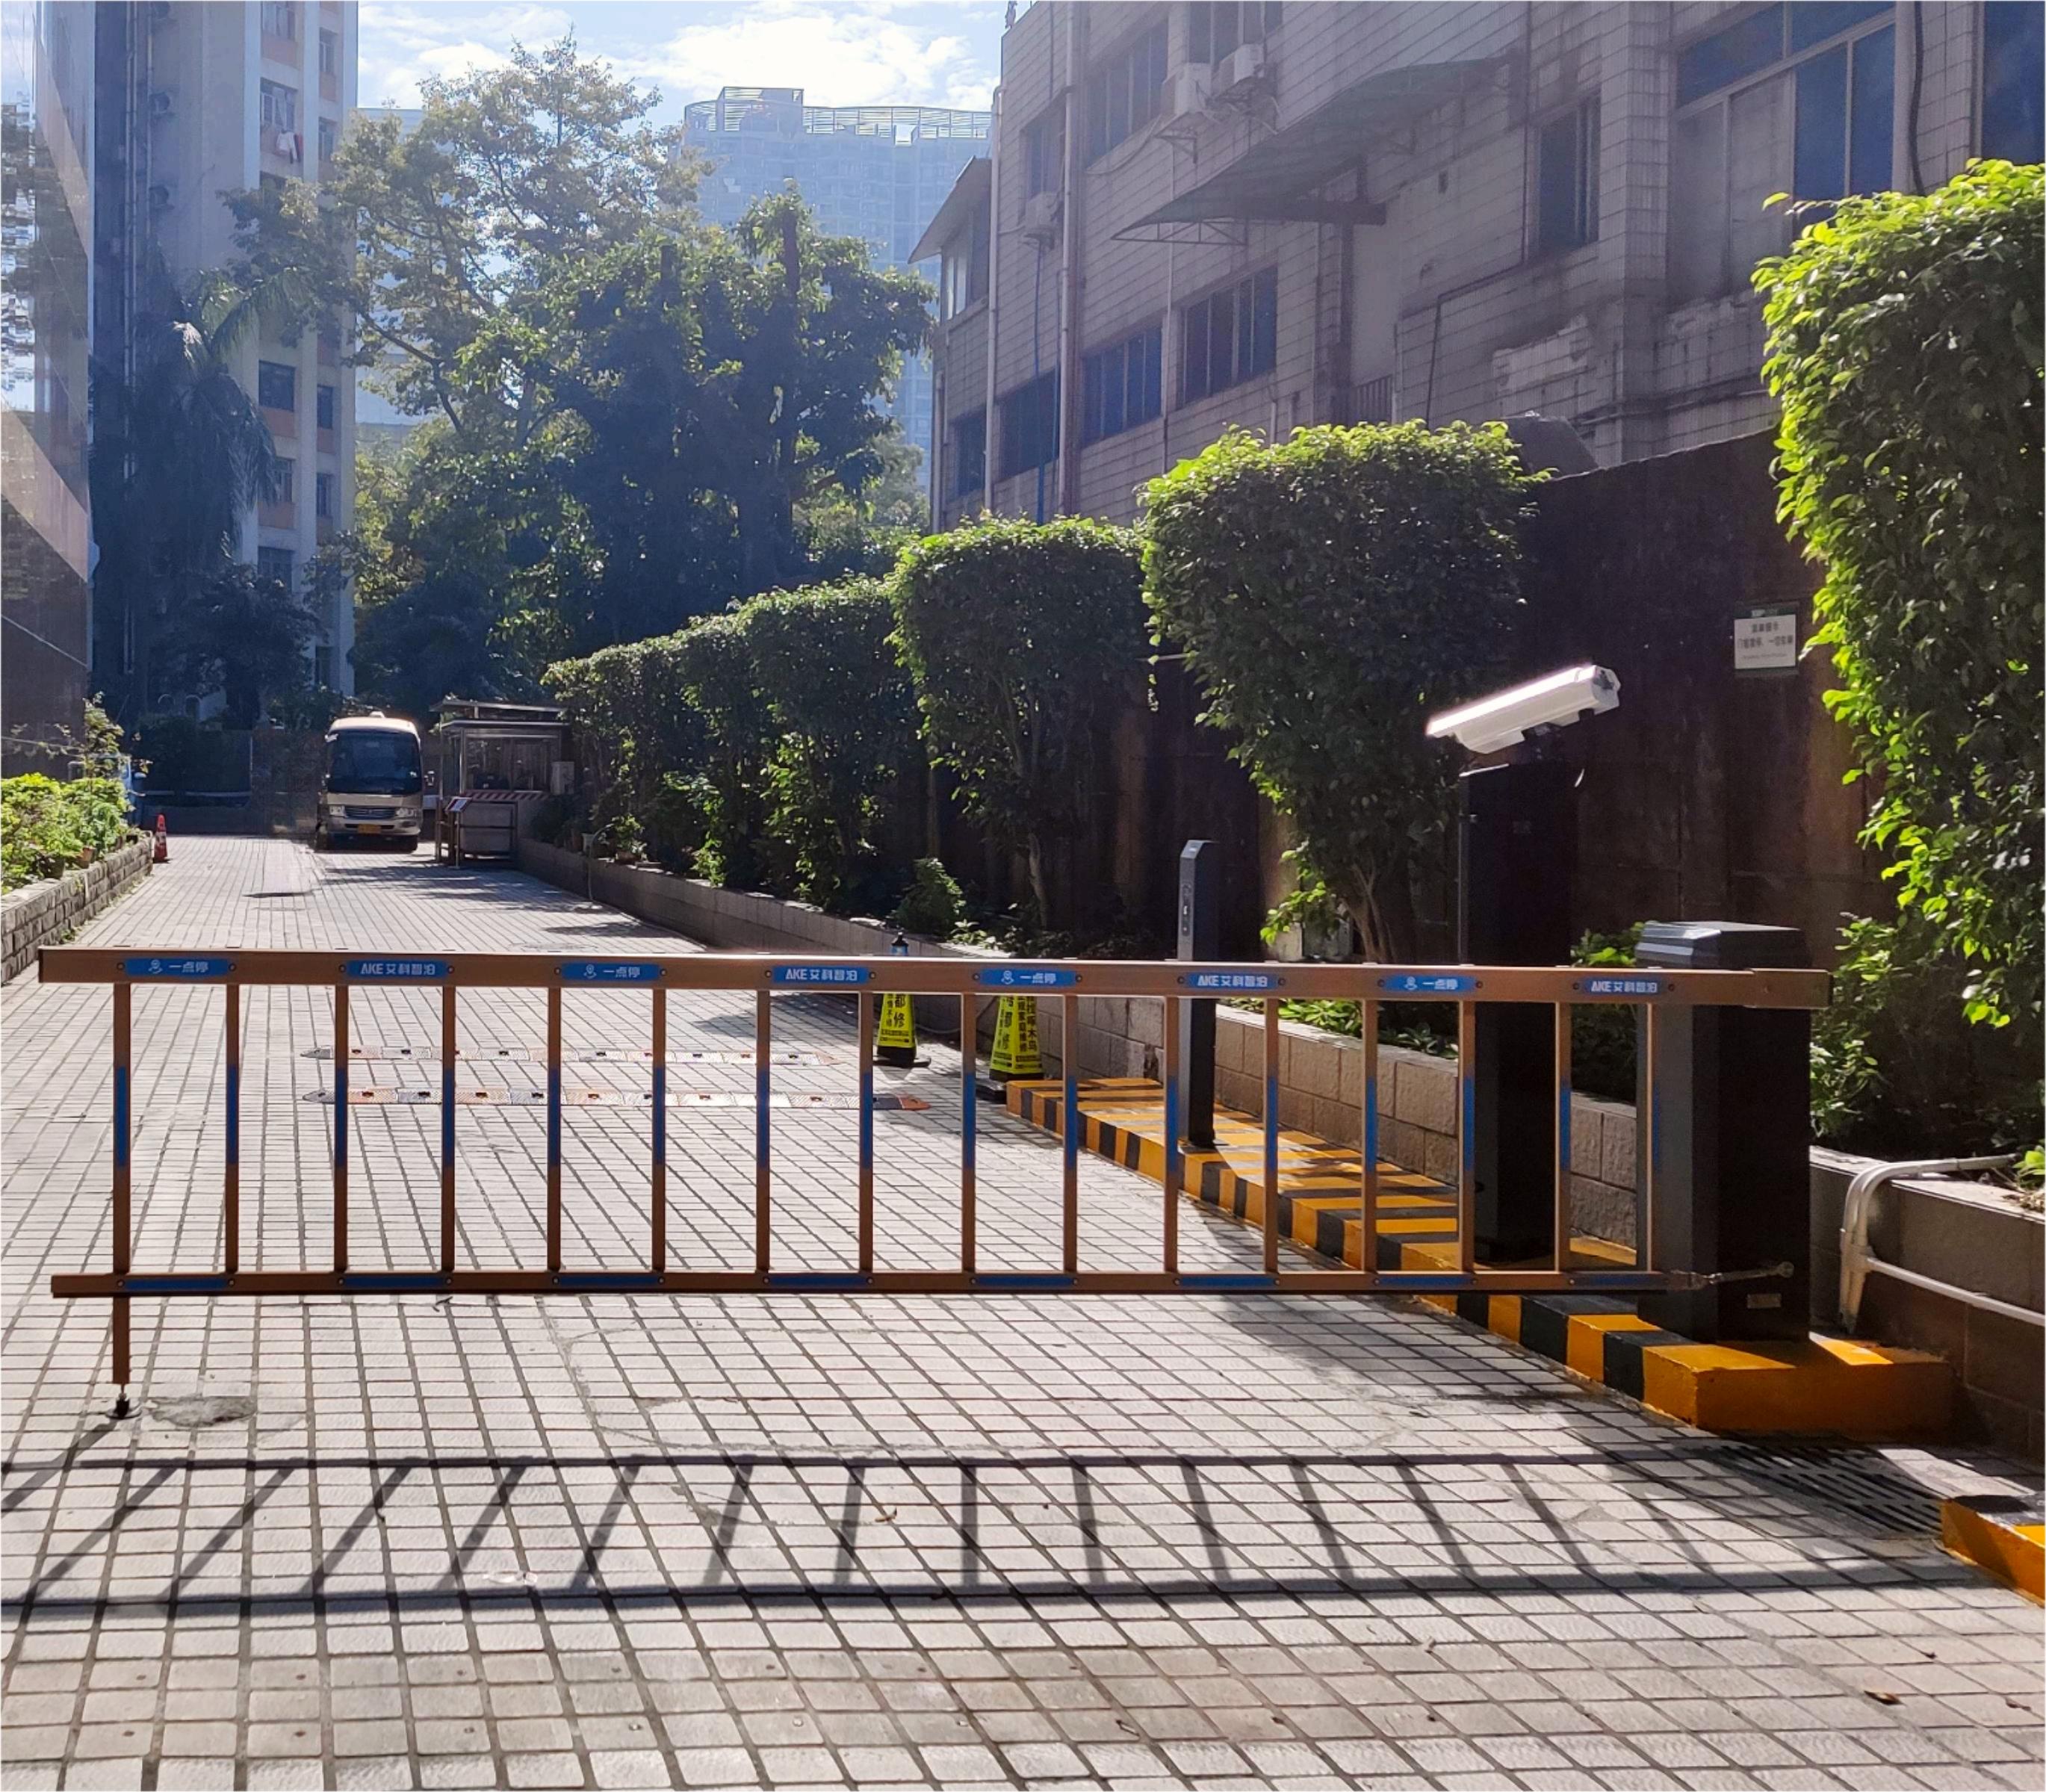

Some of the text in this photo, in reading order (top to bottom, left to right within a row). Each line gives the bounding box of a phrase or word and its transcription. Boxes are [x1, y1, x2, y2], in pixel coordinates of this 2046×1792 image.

[169, 961, 208, 973] 一点停
[604, 966, 641, 979] 一点停
[1020, 972, 1057, 985] 一点停
[1422, 979, 1459, 990] 一点停
